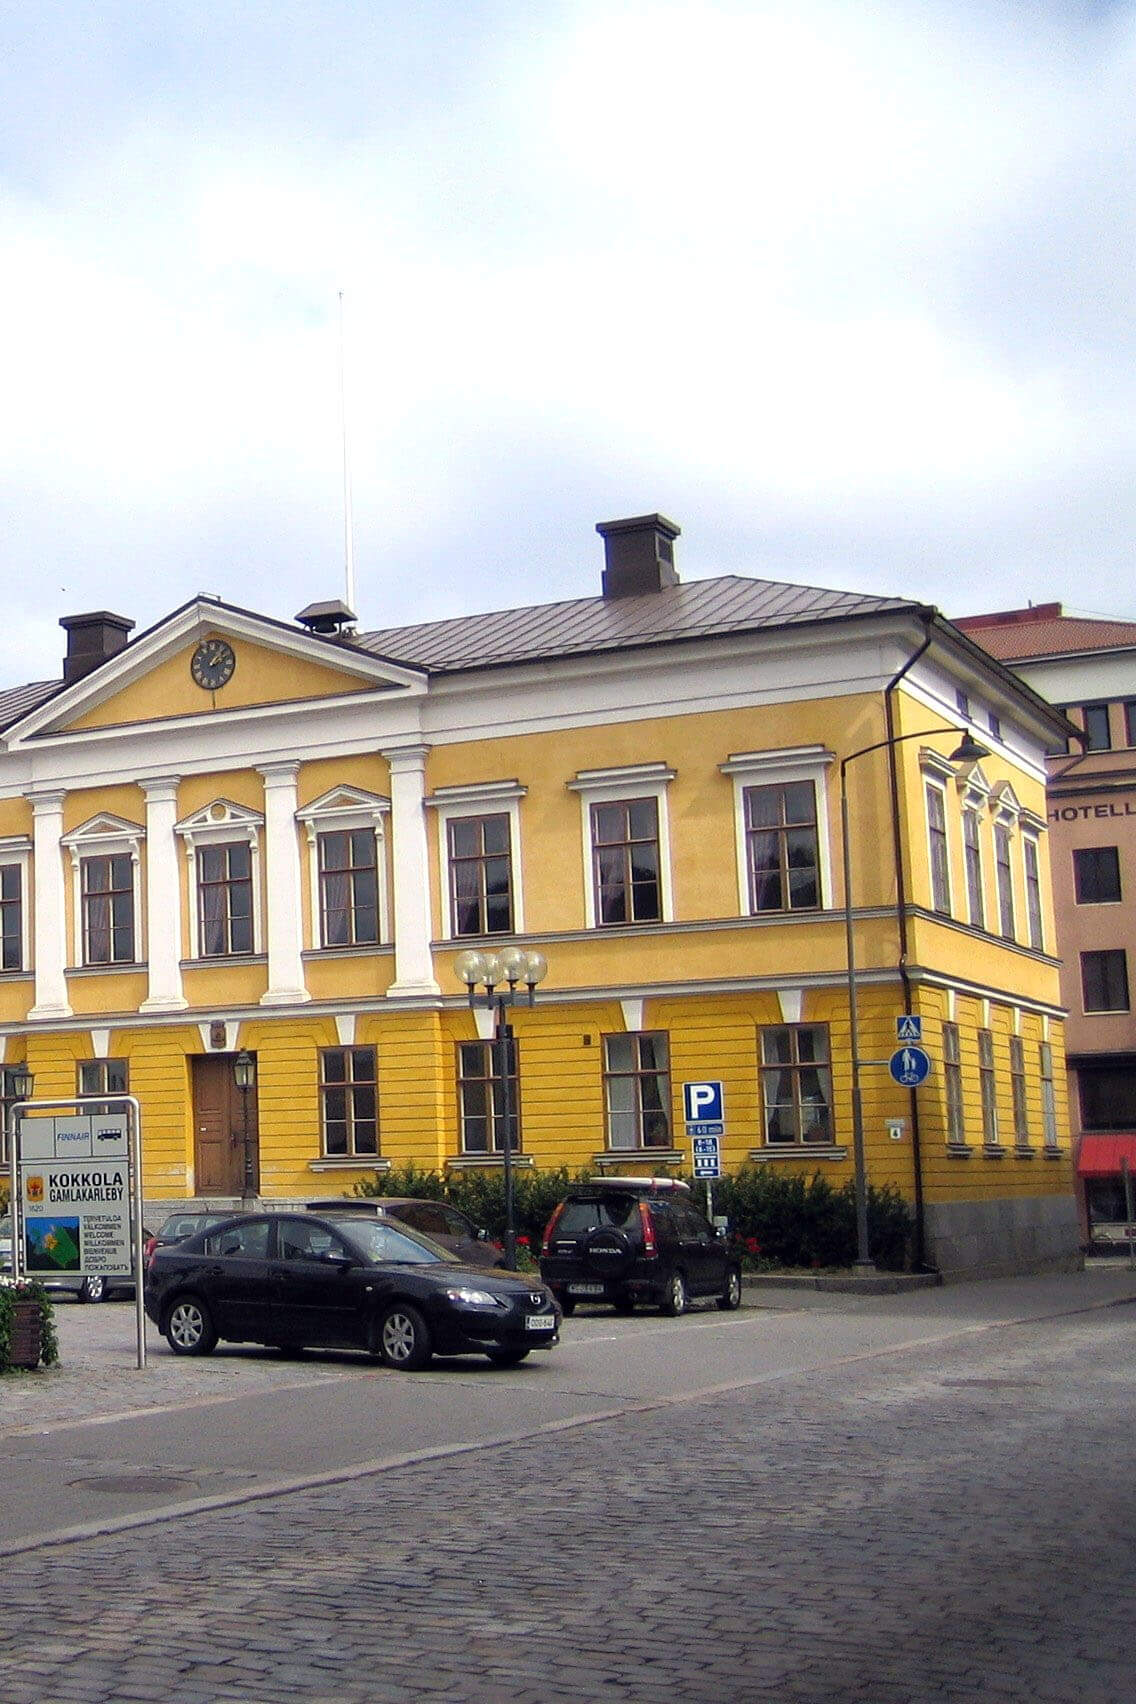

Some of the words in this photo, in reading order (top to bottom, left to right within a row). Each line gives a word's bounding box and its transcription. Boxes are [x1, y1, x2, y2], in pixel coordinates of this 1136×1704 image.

[690, 1084, 715, 1119] P
[57, 1132, 90, 1141] FINNAIR
[49, 1172, 123, 1187] KOKKOLA
[49, 1187, 124, 1202] GAMLAKARLEBY
[83, 1239, 125, 1247] WILLKOMMEN
